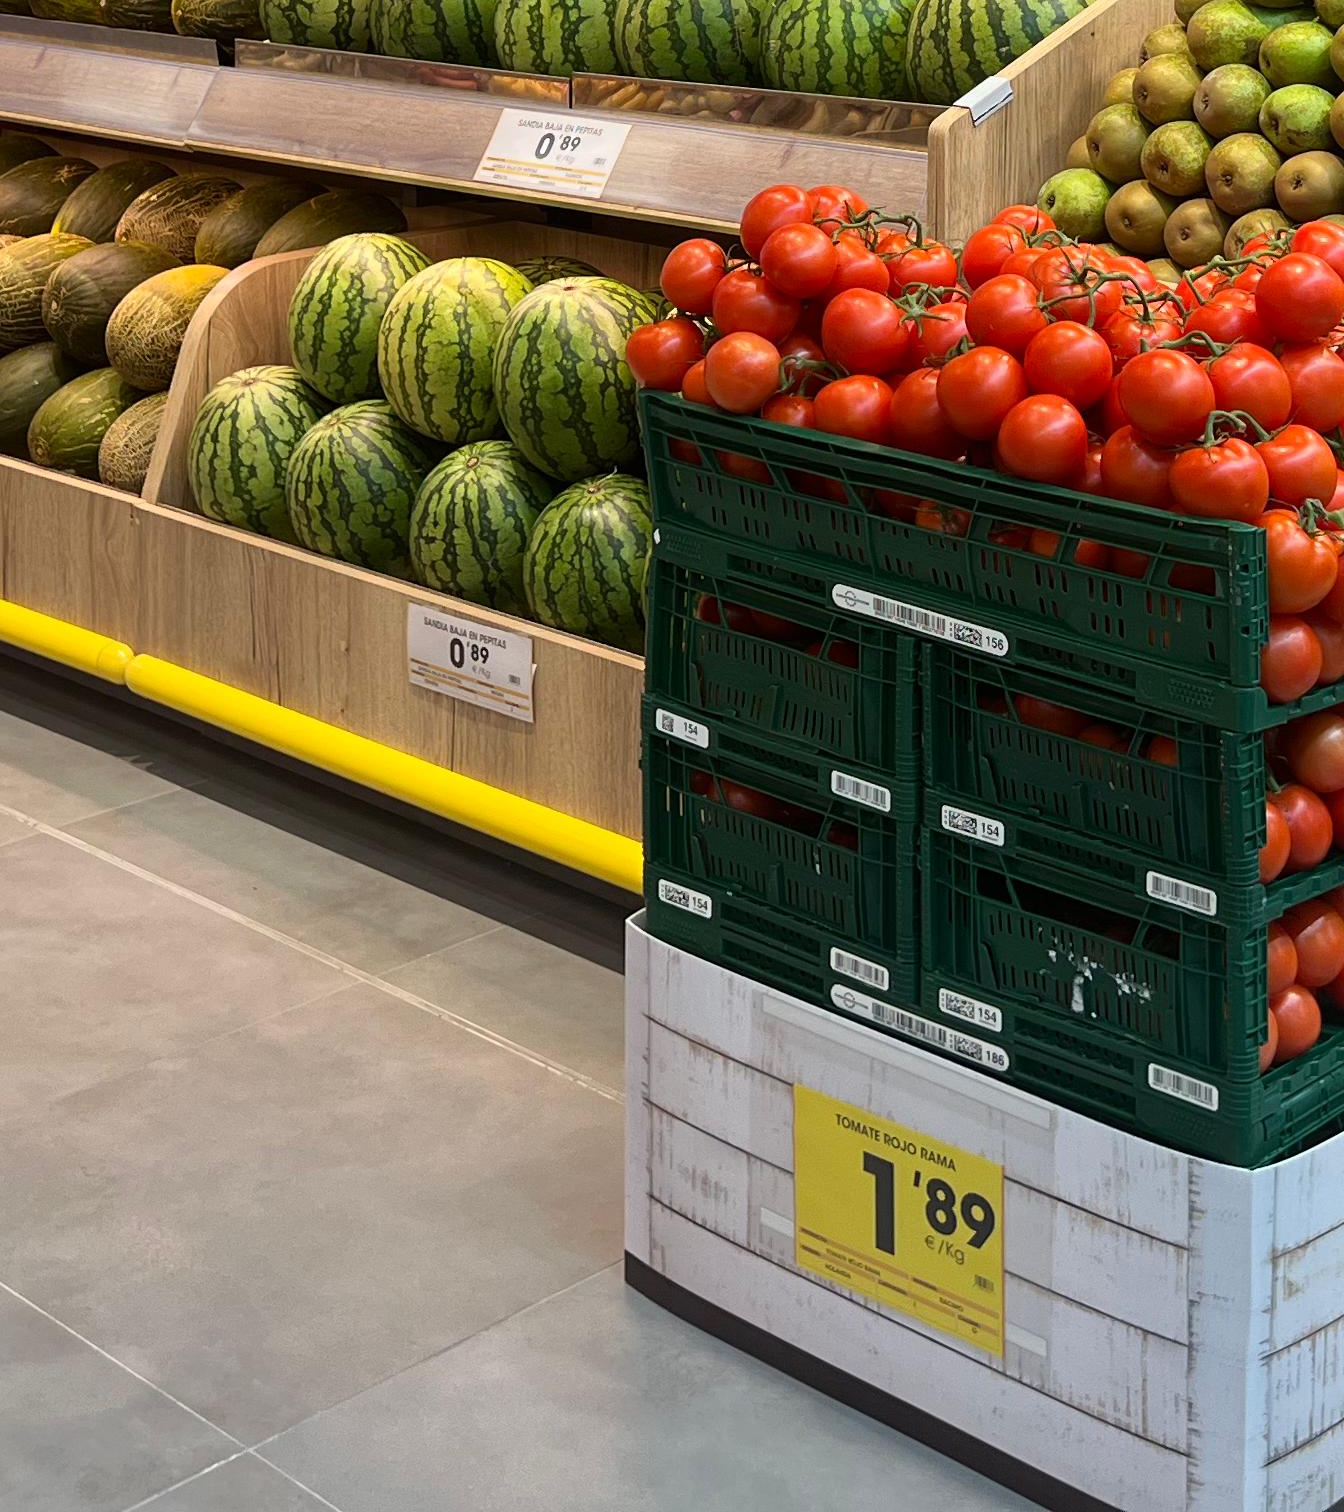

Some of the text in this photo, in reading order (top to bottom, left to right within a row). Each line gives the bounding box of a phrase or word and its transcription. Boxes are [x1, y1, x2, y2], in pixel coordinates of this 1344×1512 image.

[517, 119, 544, 129] SANDIA
[544, 122, 563, 131] BAJA
[575, 125, 604, 136] PEPITAS
[424, 616, 507, 649] SANDIA BAJA EN PEPITAS
[985, 635, 1004, 651] 156
[450, 638, 489, 668] 0'89
[683, 721, 698, 736] 154
[981, 822, 1000, 838] 154
[692, 896, 708, 911] 154
[978, 1006, 997, 1023] 154
[836, 1113, 956, 1172] TOMATE ROJO RAMA
[863, 1151, 995, 1256] 1'89
